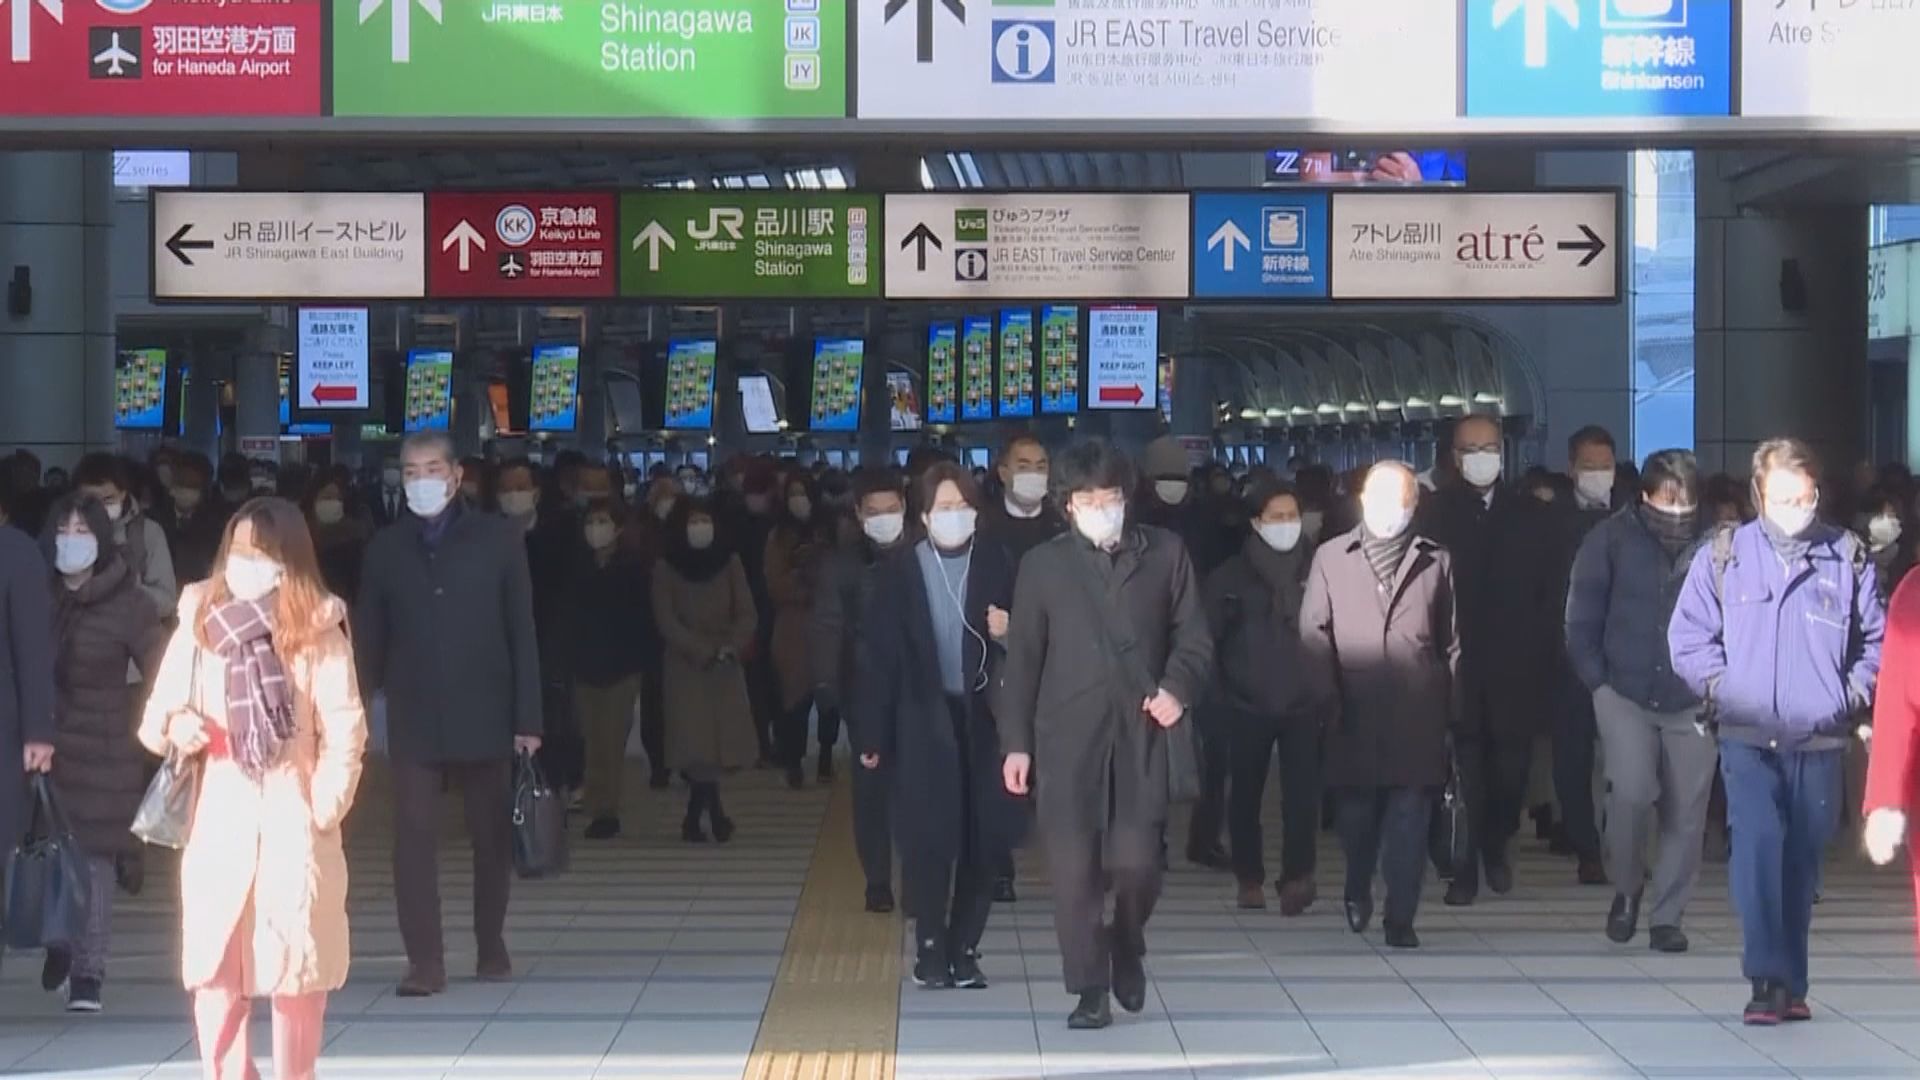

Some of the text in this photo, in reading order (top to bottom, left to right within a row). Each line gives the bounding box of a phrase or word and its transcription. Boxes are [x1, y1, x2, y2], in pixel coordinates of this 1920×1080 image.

[600, 3, 753, 39] Shinagawa
[152, 25, 296, 54] 羽田空港方面
[794, 27, 812, 41] JK
[1066, 20, 1342, 47] JR EAST Travel Service
[1768, 22, 1813, 43] Atre
[600, 41, 697, 71] Station
[1601, 35, 1695, 67] 新幹線
[152, 59, 291, 78] for Haneda Airport
[793, 63, 812, 79] JY
[1601, 71, 1704, 90] Shinkansen
[540, 207, 597, 227] 京急線
[687, 207, 744, 240] JR
[755, 207, 835, 237] 品川駅
[992, 208, 1071, 223] びゅうプラザ
[224, 220, 407, 241] JR 品川イーストビル
[504, 218, 527, 233] KK
[578, 228, 601, 240] Line
[1033, 224, 1048, 233] and
[1051, 224, 1077, 233] Travel
[1080, 224, 1110, 233] Service
[1112, 224, 1141, 233] Center
[1351, 222, 1442, 245] アトレ品川
[755, 240, 832, 259] Shinagawa
[1456, 224, 1545, 263] atré
[224, 247, 404, 263] JR Shinagawa East Building
[529, 250, 603, 267] 羽田空港方面
[993, 246, 1176, 264] JR EAST Travel Service Center
[1262, 255, 1310, 272] 新幹線
[1350, 249, 1441, 263] Atre Shinagawa
[530, 268, 600, 279] for Haneda Airport
[755, 260, 804, 276] Station
[1262, 274, 1314, 283] Shinkansen
[312, 360, 354, 369] KEEP LEFT
[1099, 361, 1146, 370] KEEP RIGHT
